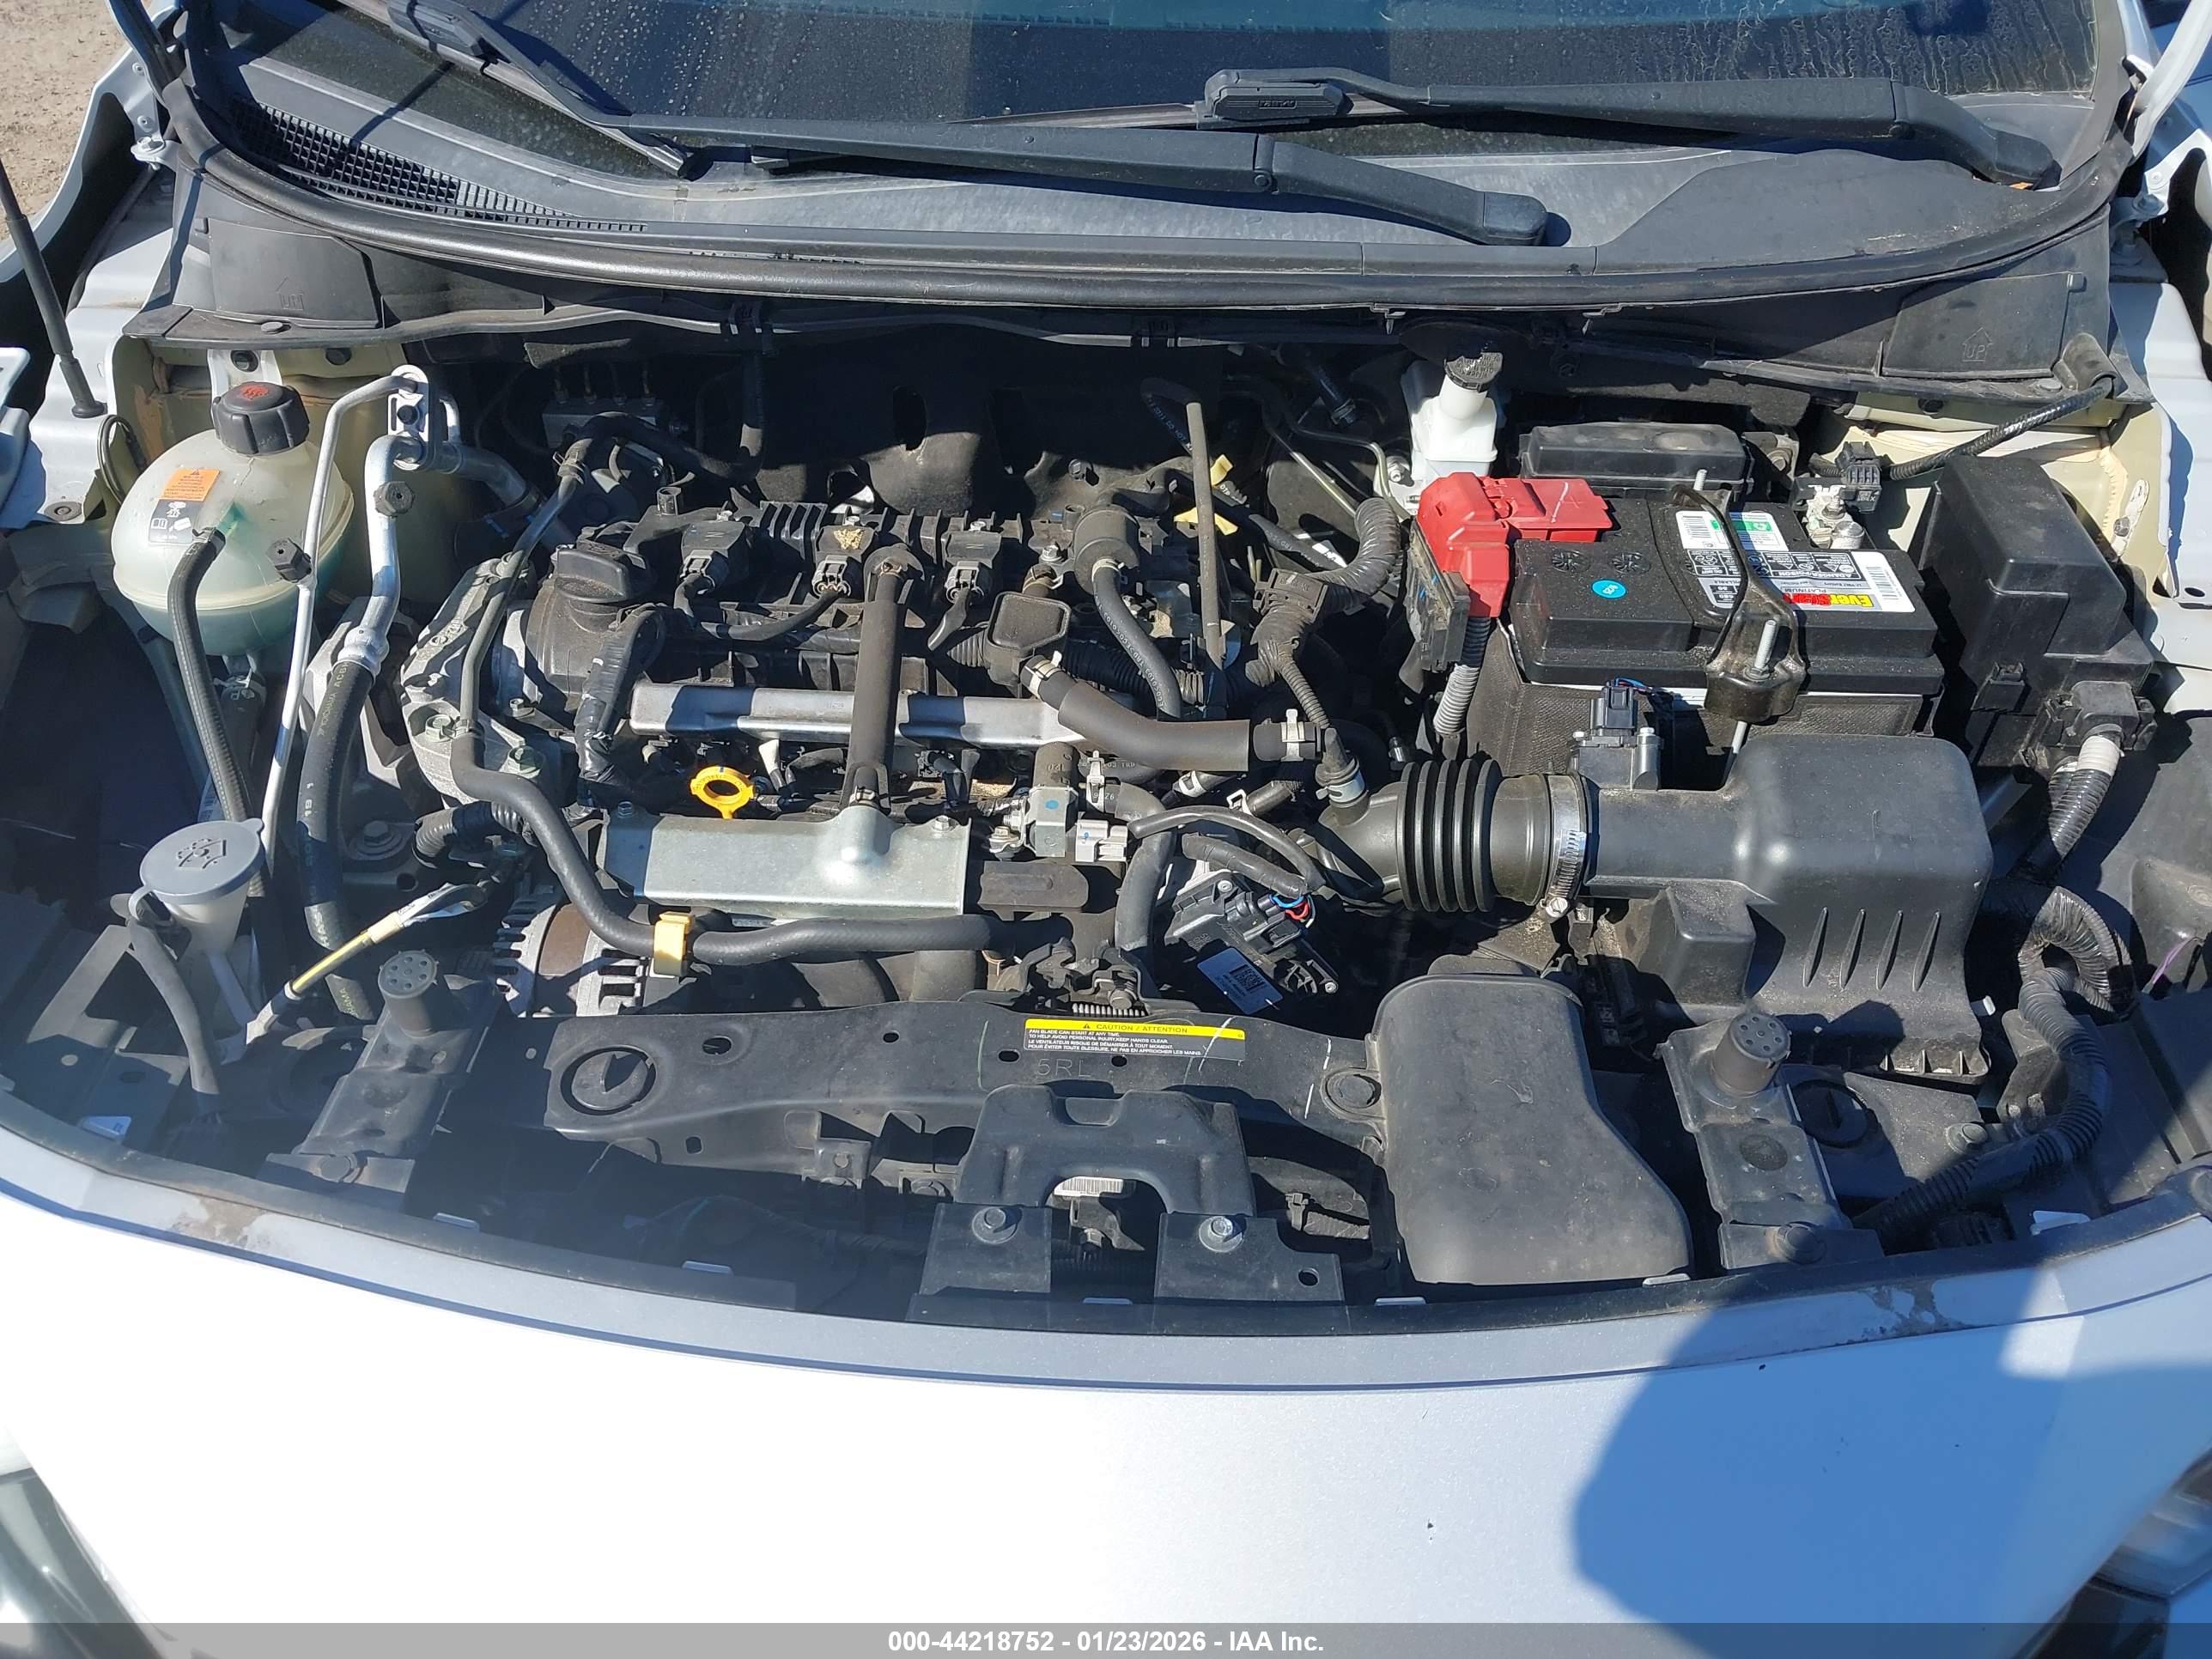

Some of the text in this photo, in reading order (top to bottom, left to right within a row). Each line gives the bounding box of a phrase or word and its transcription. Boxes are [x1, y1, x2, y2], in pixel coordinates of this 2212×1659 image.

[1966, 344, 1985, 360] UP
[1782, 592, 1875, 608] EverStart
[1096, 1023, 1133, 1031] CAUTION
[1142, 1025, 1188, 1034] ATTENTION
[1036, 1058, 1092, 1078] 5RL
